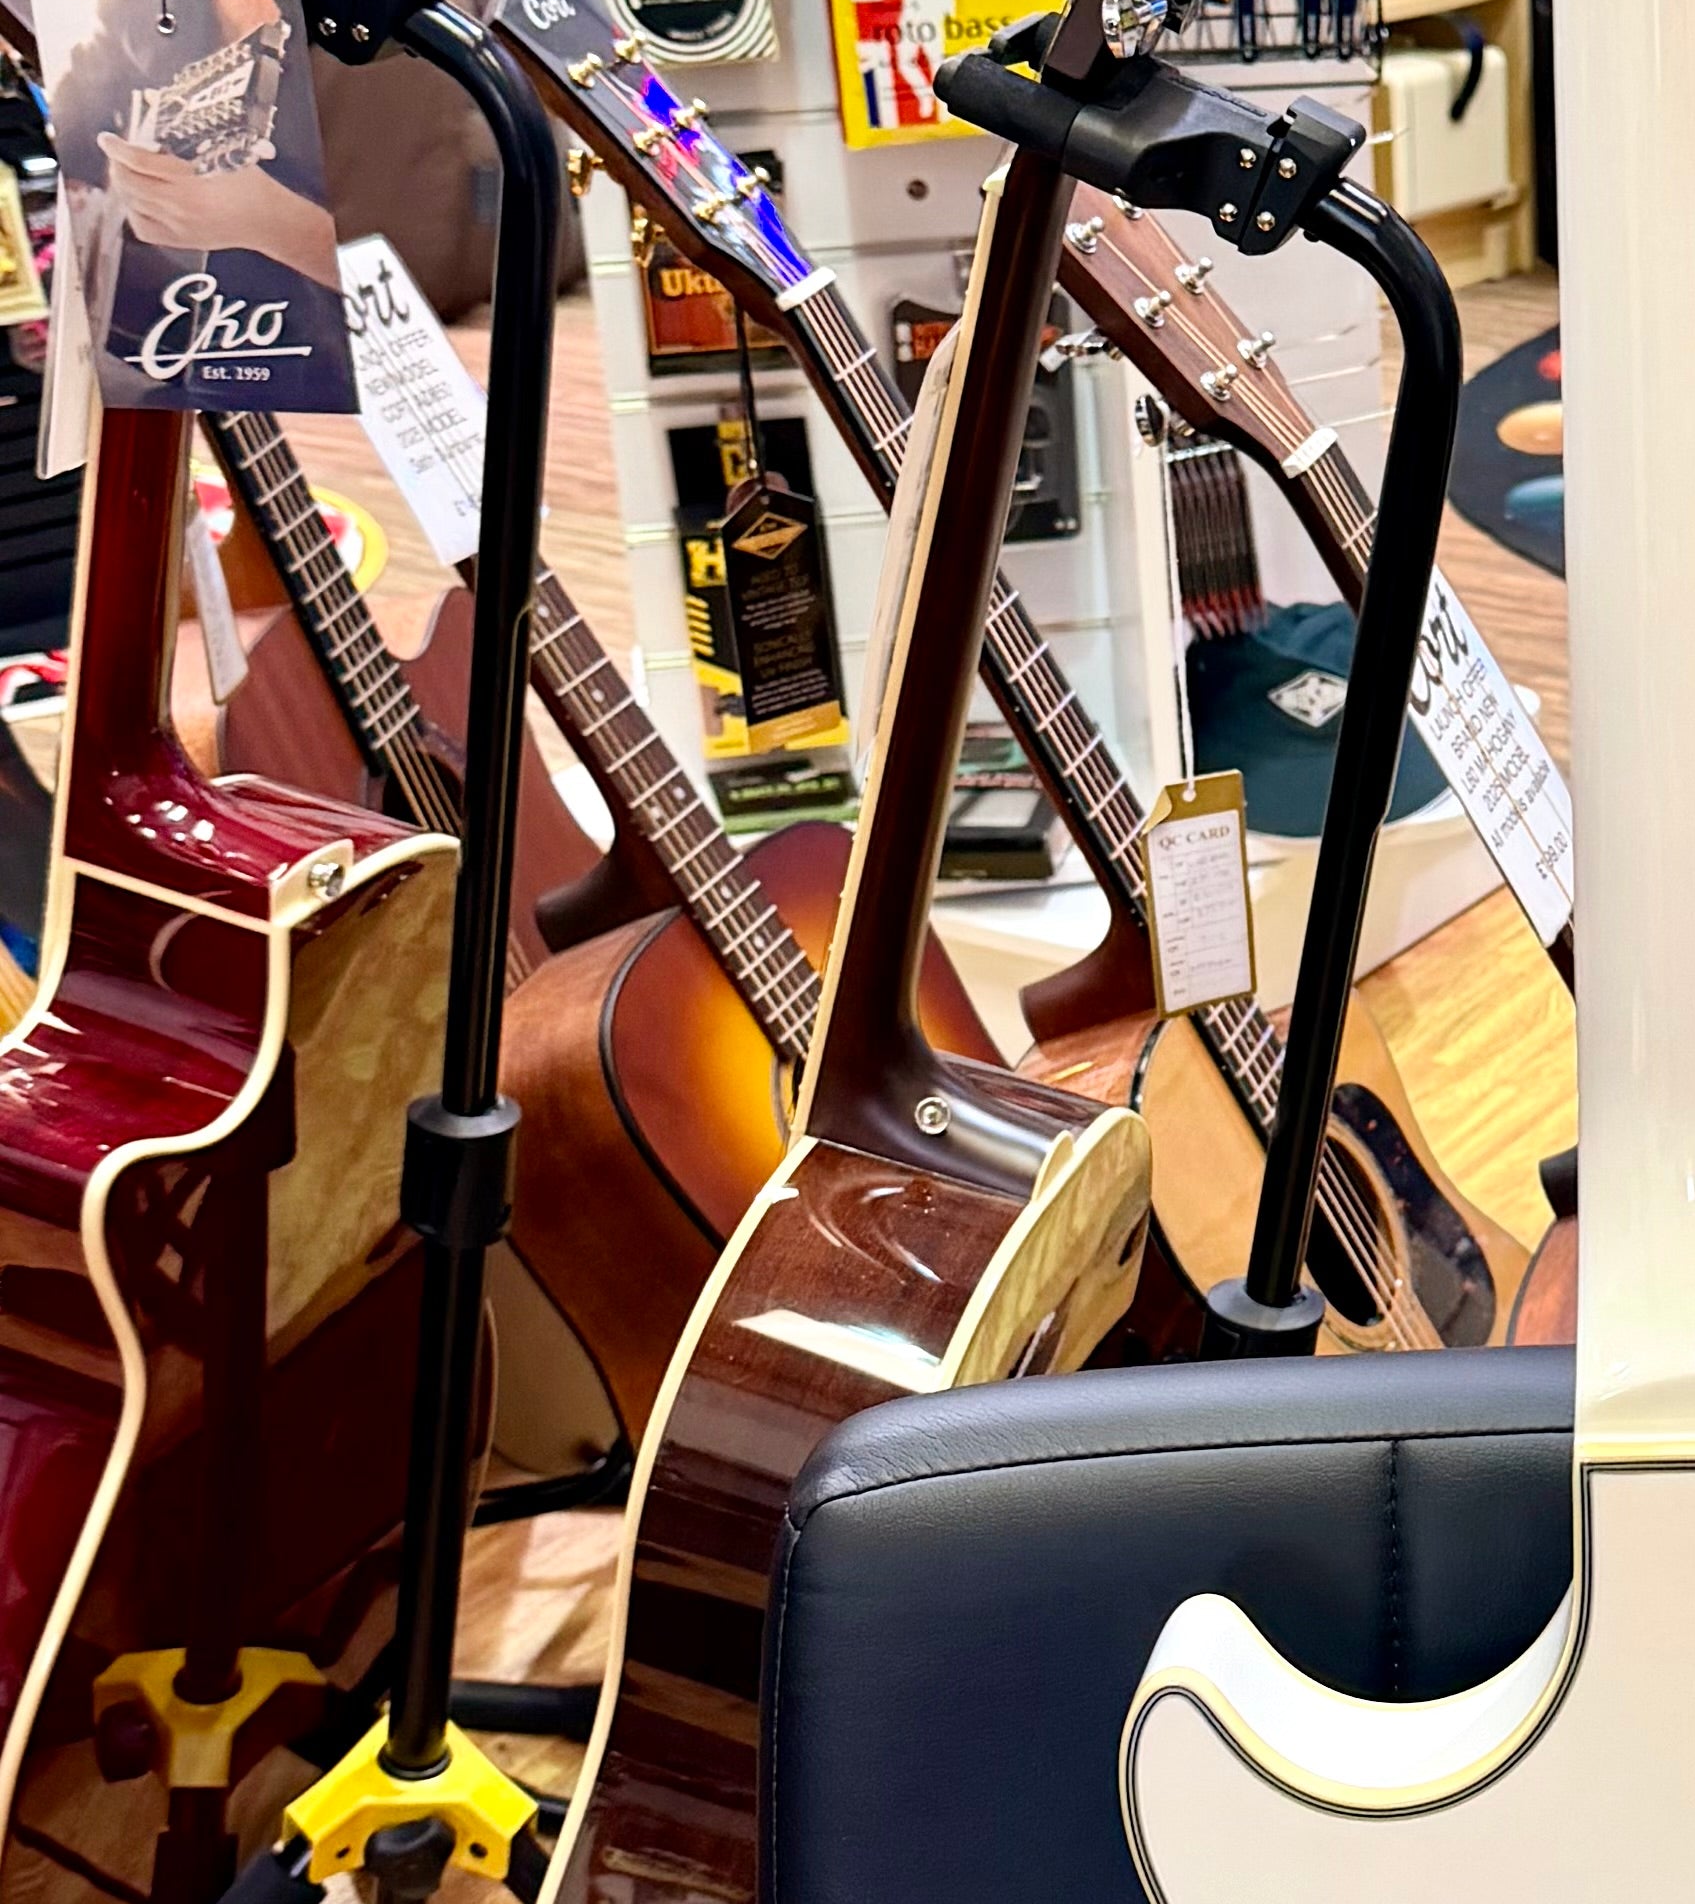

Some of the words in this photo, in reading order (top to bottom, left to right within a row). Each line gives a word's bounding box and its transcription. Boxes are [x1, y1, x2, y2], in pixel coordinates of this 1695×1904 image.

[871, 20, 937, 46] roto
[343, 259, 411, 337] ort
[140, 272, 290, 381] Eko
[202, 365, 233, 381] Est.
[235, 365, 271, 382] 1959
[1159, 833, 1183, 852] QC
[1186, 825, 1231, 844] CARD
